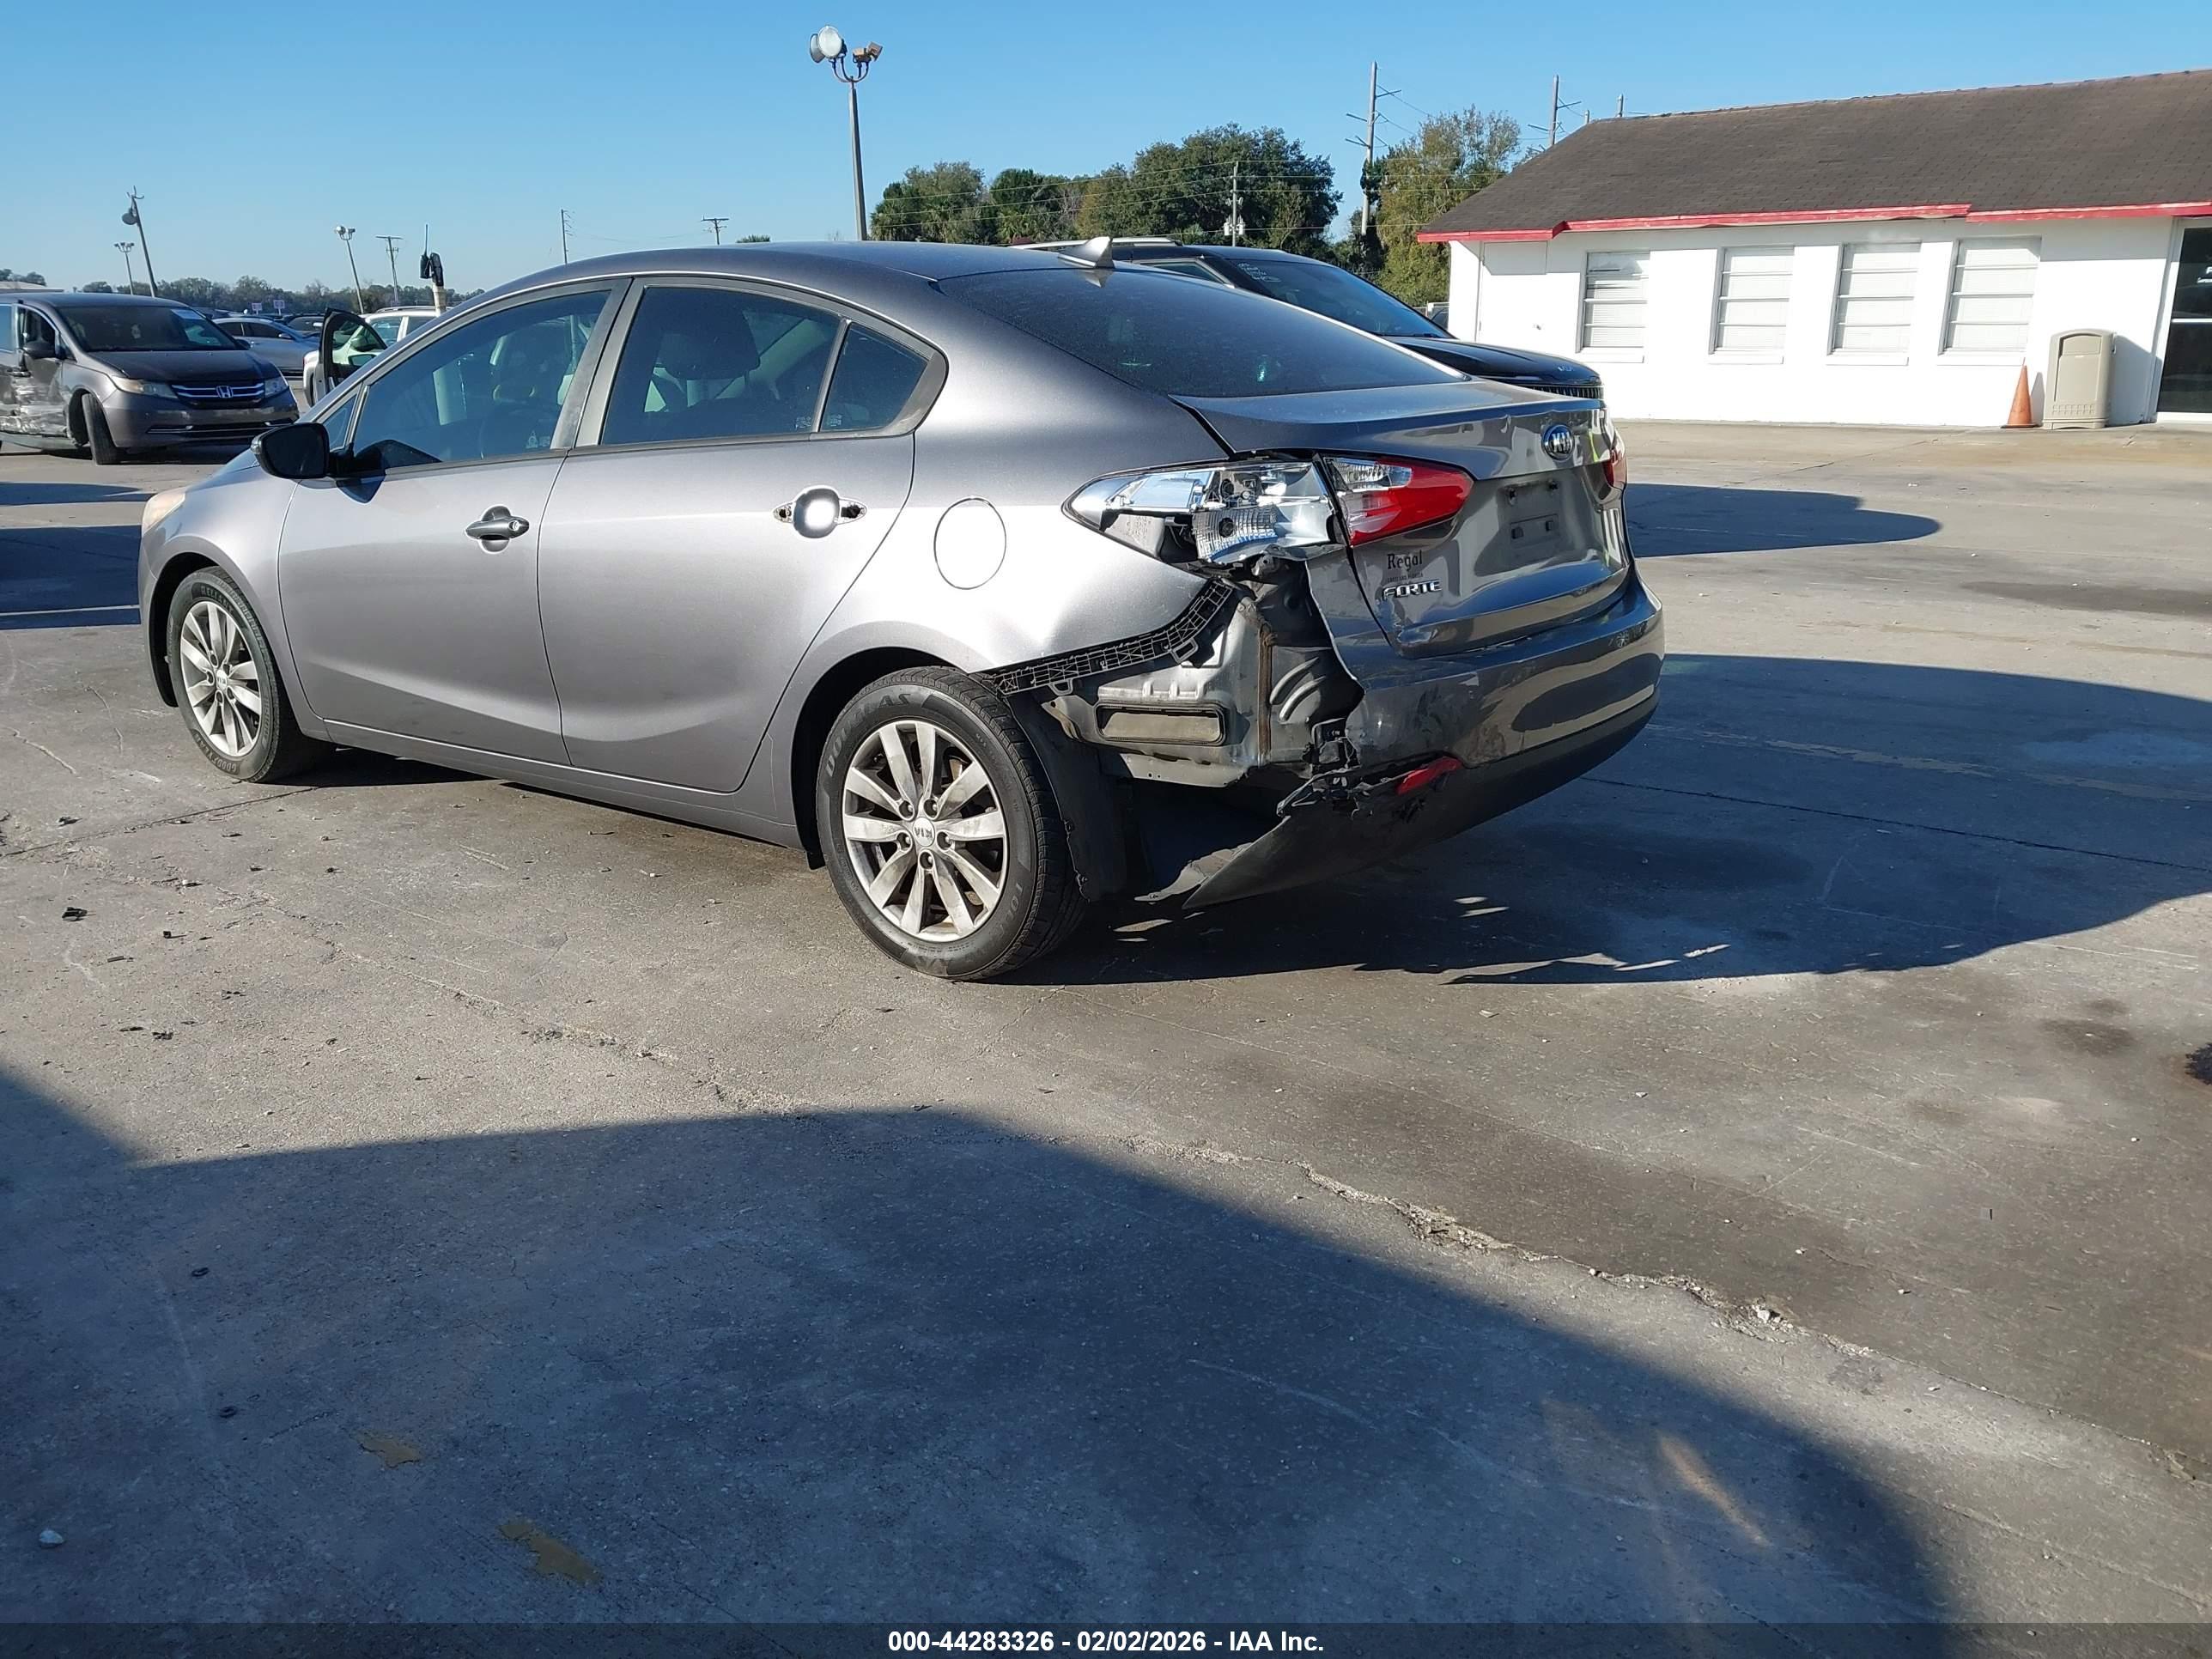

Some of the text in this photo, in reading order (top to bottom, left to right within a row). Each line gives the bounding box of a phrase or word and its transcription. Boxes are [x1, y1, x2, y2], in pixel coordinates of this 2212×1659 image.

[1387, 549, 1423, 571] Regal
[1382, 578, 1443, 601] FORTE
[914, 826, 933, 838] KIA
